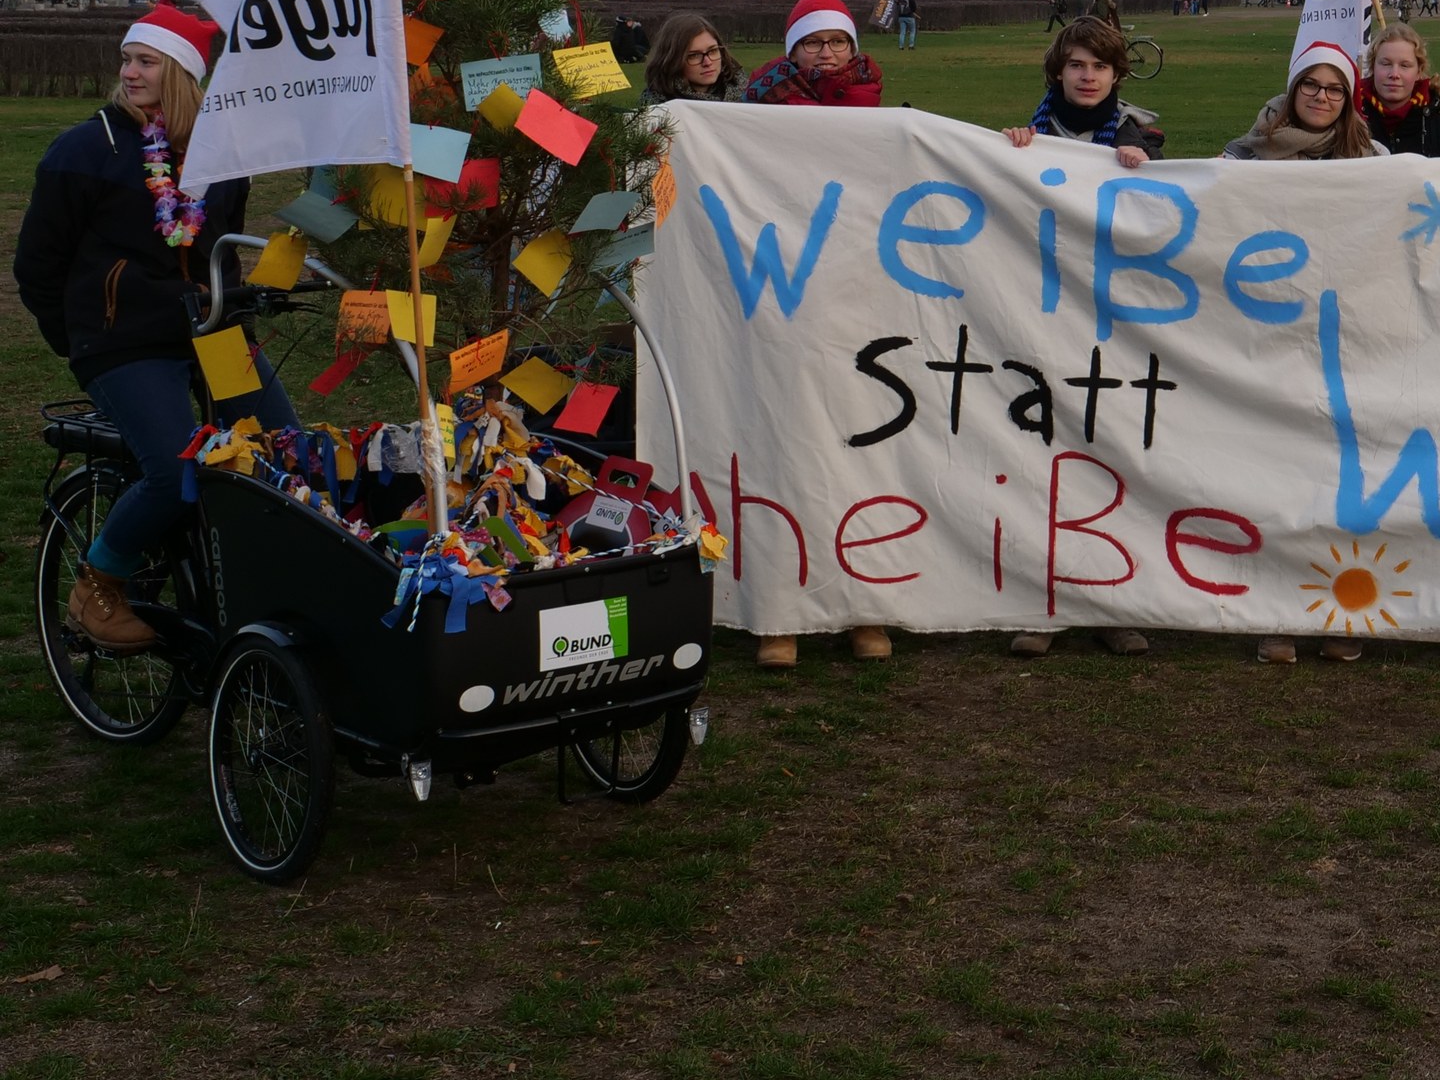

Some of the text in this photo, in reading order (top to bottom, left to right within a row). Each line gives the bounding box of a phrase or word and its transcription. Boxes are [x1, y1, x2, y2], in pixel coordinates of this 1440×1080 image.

[595, 507, 617, 520] BUND
[731, 451, 1262, 618] heiße
[570, 633, 602, 653] BUND
[502, 654, 665, 705] winther
